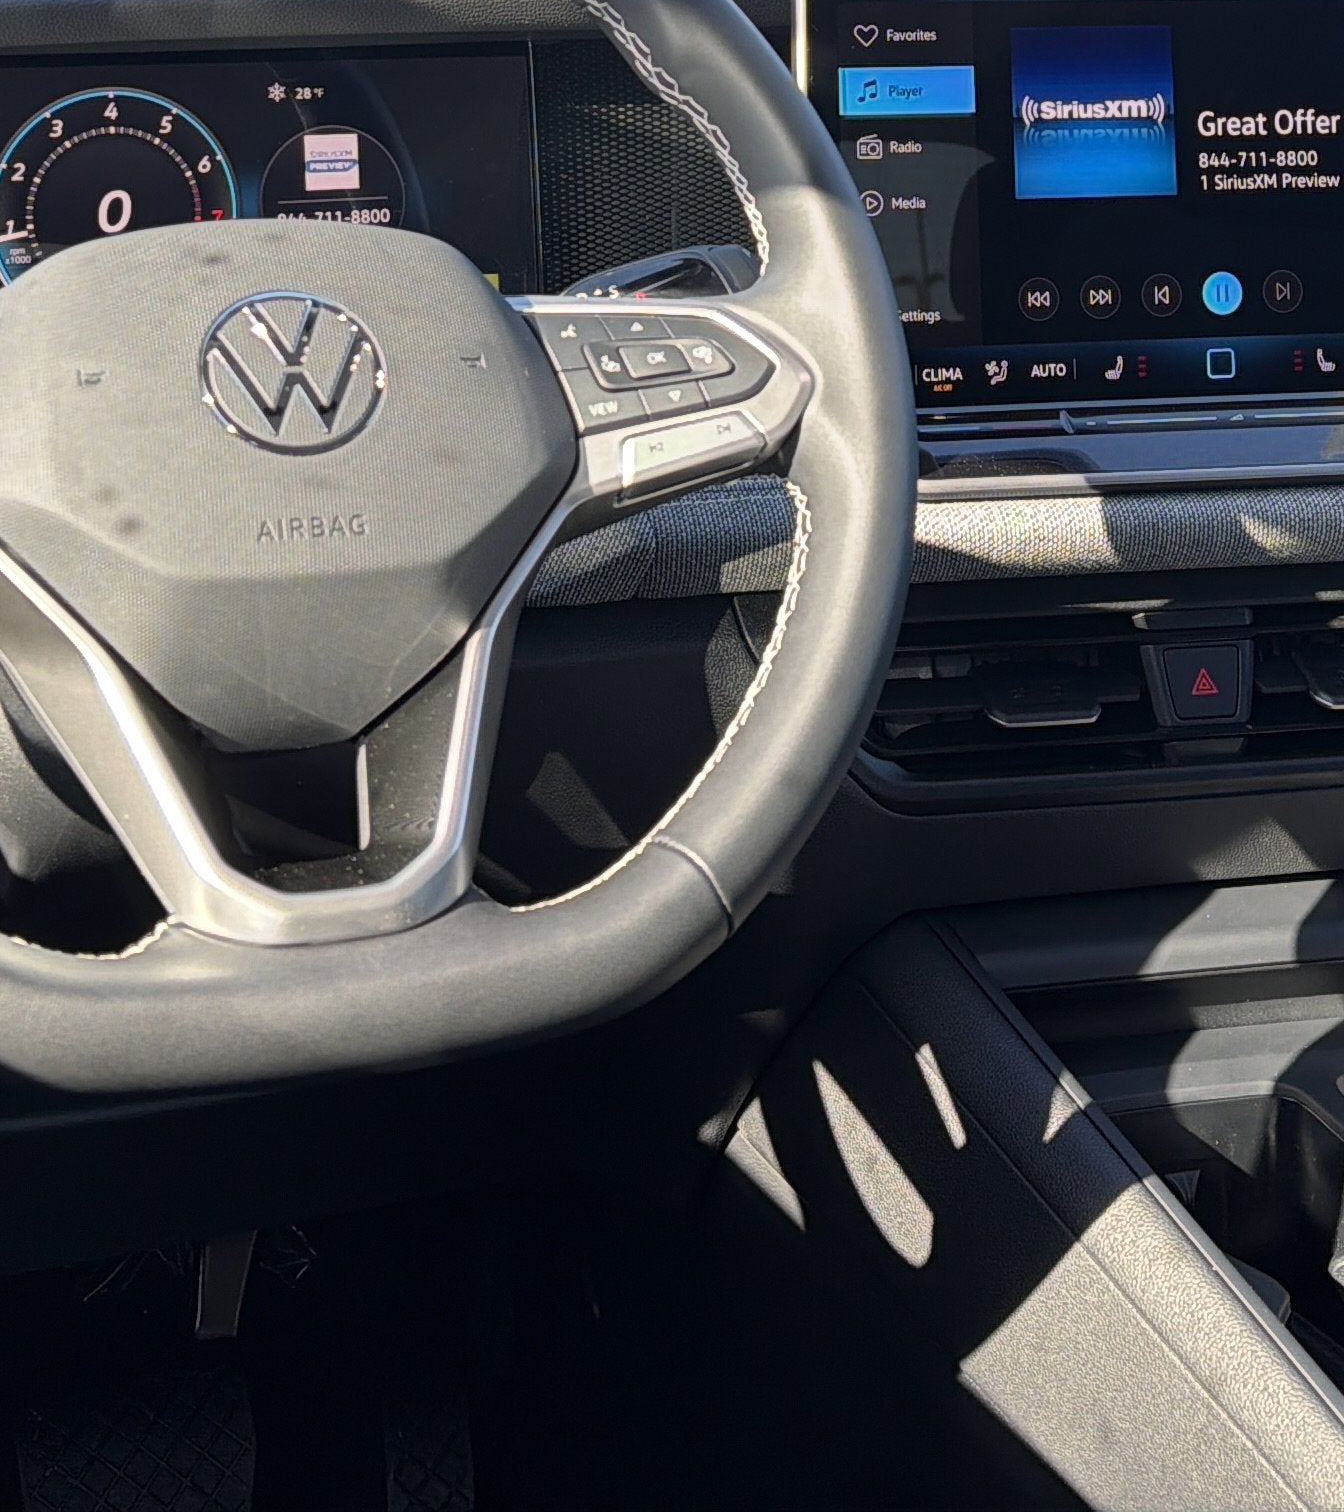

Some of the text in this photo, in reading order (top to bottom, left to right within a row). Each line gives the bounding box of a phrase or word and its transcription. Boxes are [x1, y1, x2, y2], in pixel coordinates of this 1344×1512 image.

[886, 29, 937, 42] Favorites
[295, 87, 312, 101] 28
[888, 85, 924, 101] Player
[104, 101, 118, 120] 4
[49, 119, 64, 138] 3
[159, 115, 174, 134] 5
[1197, 110, 1268, 137] Great
[1274, 108, 1341, 136] Offer
[890, 141, 923, 154] Radio
[197, 154, 212, 174] 6
[1198, 150, 1318, 169] 844-711-8800
[11, 162, 27, 182] 2
[1200, 172, 1341, 191] 1 SiriusXM Preview
[97, 189, 133, 234] 0
[891, 196, 927, 210] Media
[277, 208, 391, 224] 711-8800
[646, 351, 667, 365] OK
[922, 367, 964, 383] CLIMA
[1030, 363, 1067, 378] AUTO
[256, 513, 370, 543] AIRBAG
